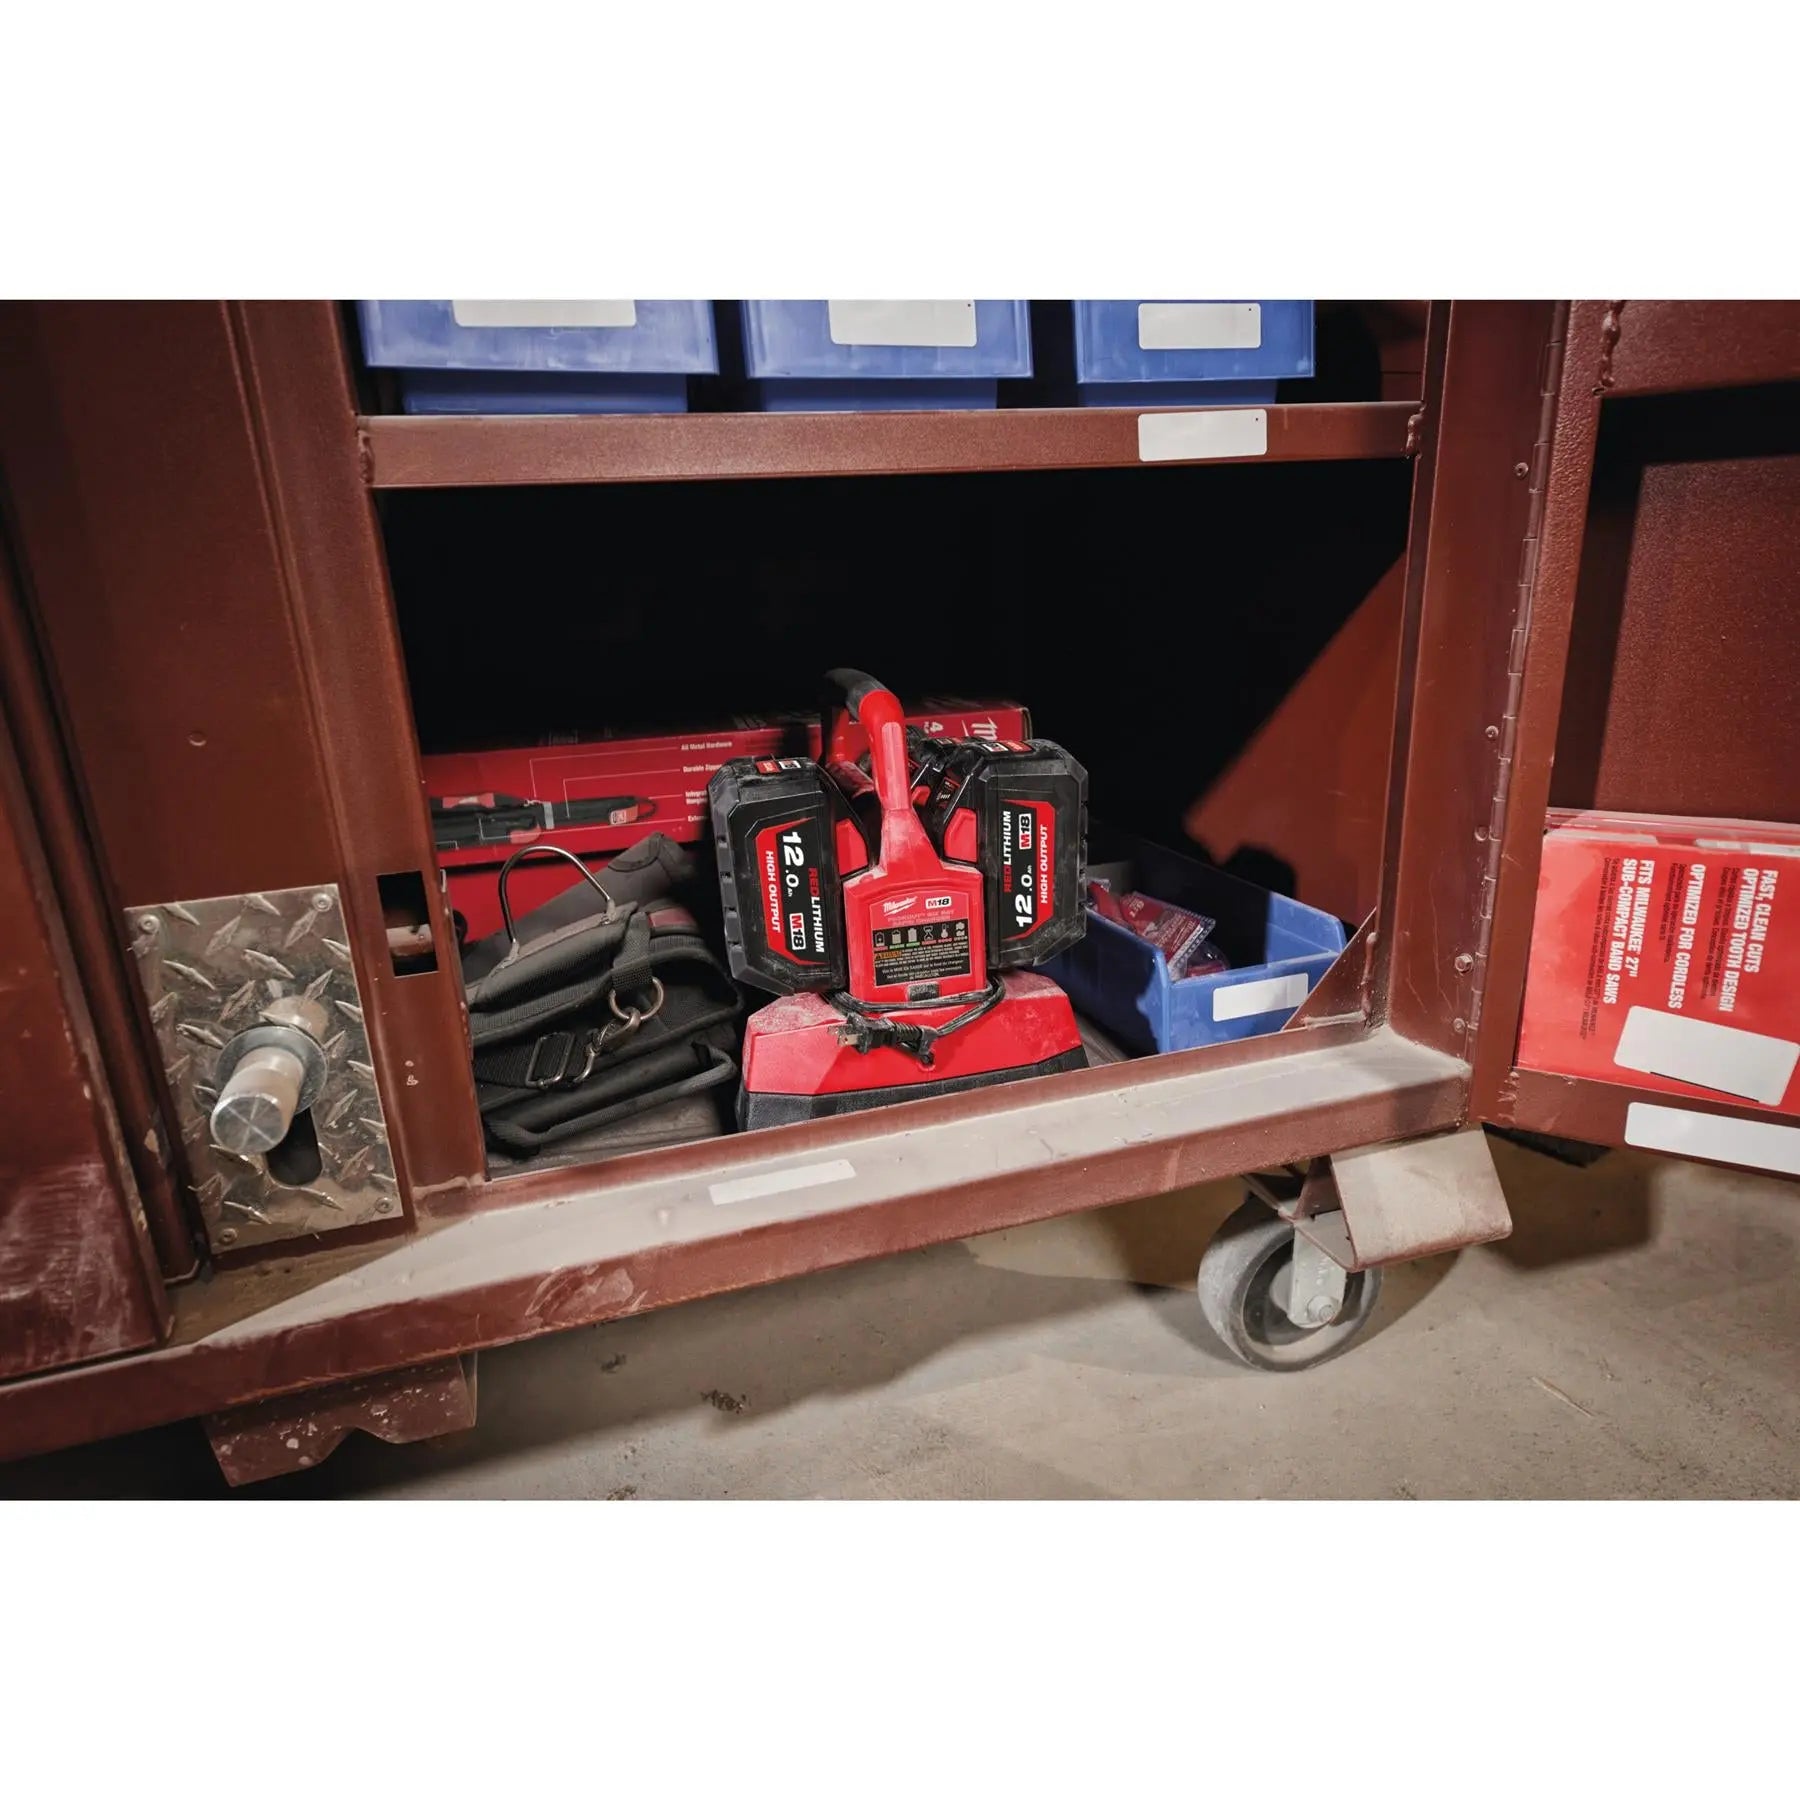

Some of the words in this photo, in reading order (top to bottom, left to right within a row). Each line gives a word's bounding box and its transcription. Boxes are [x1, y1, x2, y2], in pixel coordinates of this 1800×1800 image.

[690, 742, 705, 750] Metal
[706, 741, 733, 749] Hardware
[683, 765, 704, 773] Durable
[1020, 815, 1030, 848] M18
[1040, 825, 1048, 871] OUTPUT
[765, 850, 777, 882] HIGH
[1003, 811, 1012, 892] REDLITHIUM
[1040, 873, 1048, 904] HIGH
[1637, 859, 1655, 885] FITS
[1758, 869, 1779, 901] FAST,
[768, 883, 781, 933] OUTPUT
[808, 867, 825, 953] REDLITHIUM
[927, 898, 950, 908] M18
[1612, 858, 1638, 940] SUB-COMPACT
[1682, 864, 1706, 926] OPTIMIZED
[1733, 868, 1759, 930] OPTIMIZED
[791, 914, 804, 949] M18
[1678, 927, 1695, 950] FOR
[1750, 903, 1771, 942] CLEAN
[1607, 941, 1626, 972] BAND
[1625, 956, 1640, 977] 27"
[1726, 931, 1747, 969] TOOTH
[1744, 943, 1764, 973] CUTS
[1602, 973, 1620, 1004] SAWS
[1668, 952, 1691, 1009] CORDLESS
[1718, 970, 1740, 1012] DESIGN
